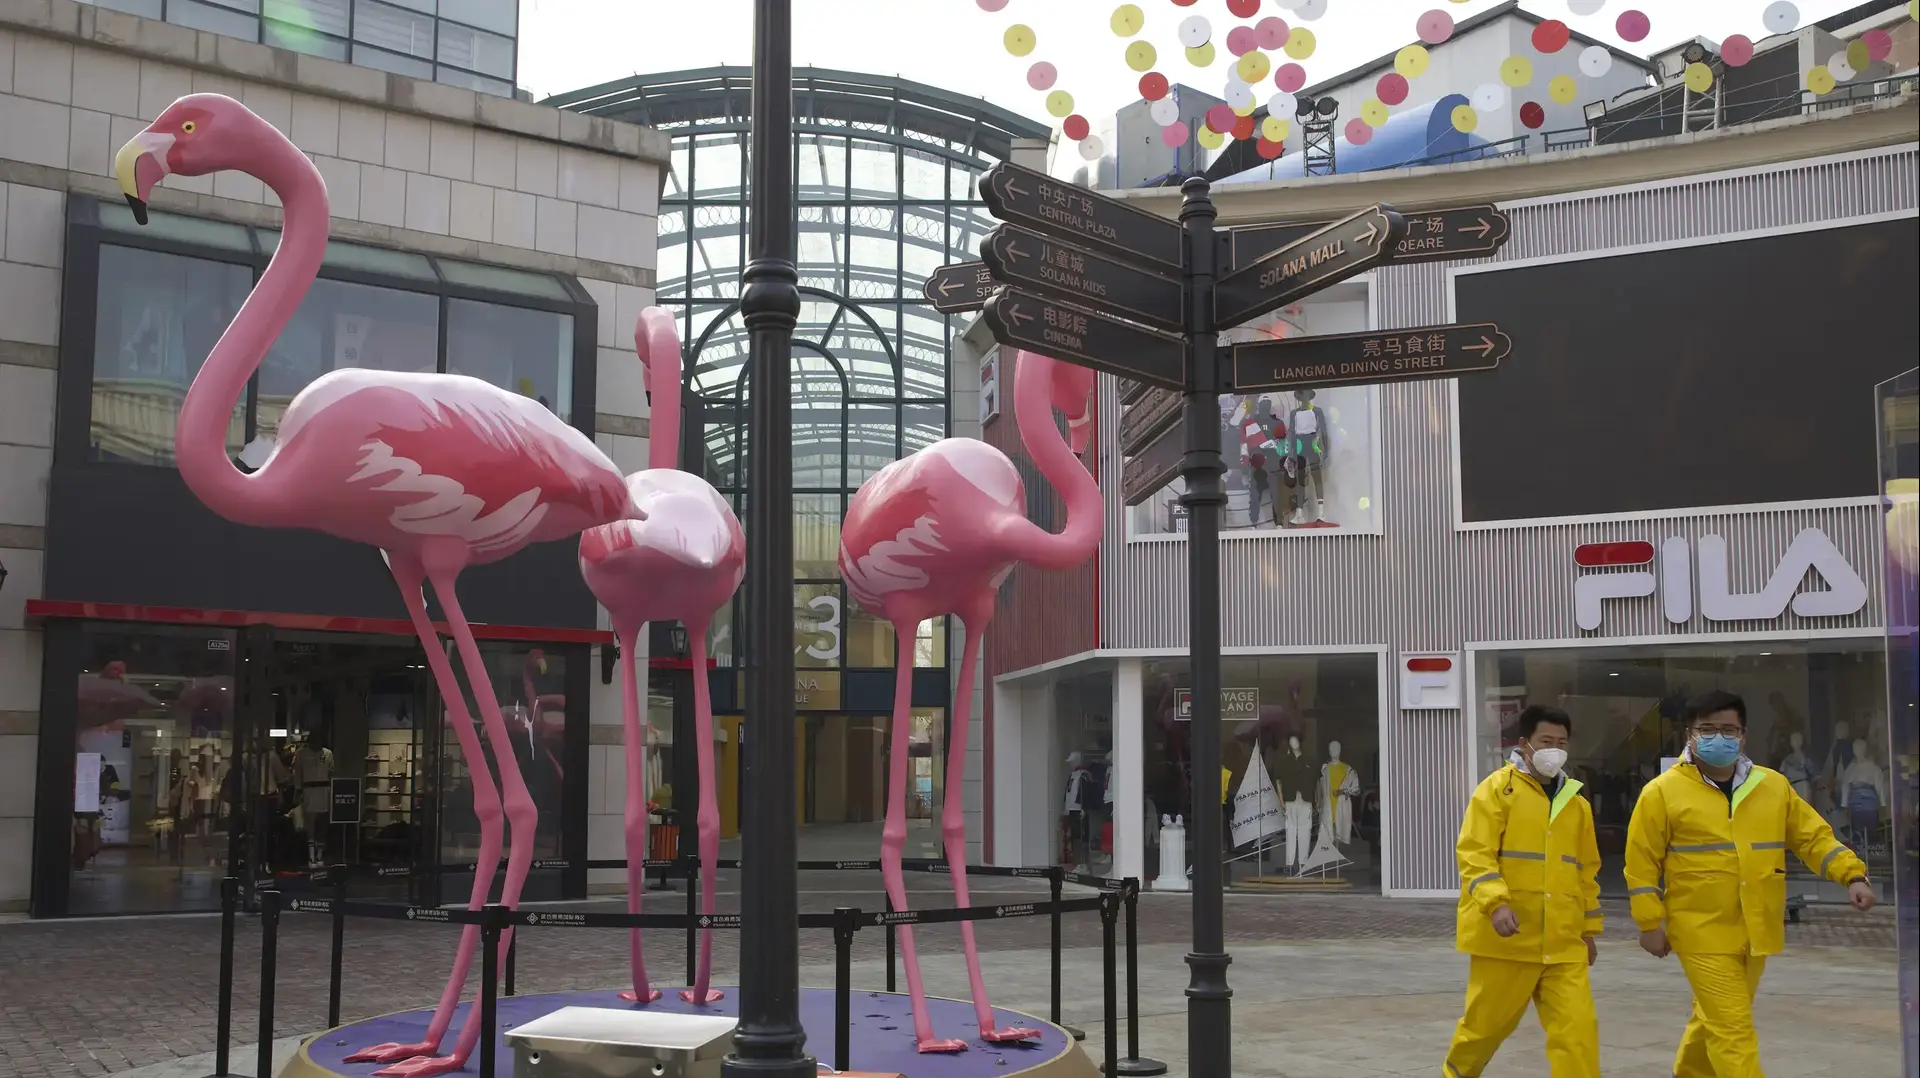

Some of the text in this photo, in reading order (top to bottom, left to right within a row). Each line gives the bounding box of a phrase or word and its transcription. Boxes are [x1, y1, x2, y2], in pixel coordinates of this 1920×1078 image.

[1038, 184, 1094, 217] 中央广场
[1039, 204, 1117, 240] CENTRAL PLAZA
[1406, 217, 1444, 235] 广场
[1395, 237, 1444, 252] QEARE
[1041, 244, 1084, 274] 儿童城
[1259, 239, 1346, 289] SOLANA MALL
[976, 268, 990, 283] 运
[1040, 267, 1106, 296] SOLANA KIDS
[1044, 306, 1088, 334] 电影院
[1044, 329, 1082, 349] CINEMA
[1363, 334, 1446, 357] 亮马食街
[1274, 355, 1446, 380] LIANGMA DINING STREET
[1574, 527, 1868, 630] FILA
[795, 678, 819, 691] NA
[1406, 658, 1452, 705] F
[1221, 691, 1255, 701] YAGE
